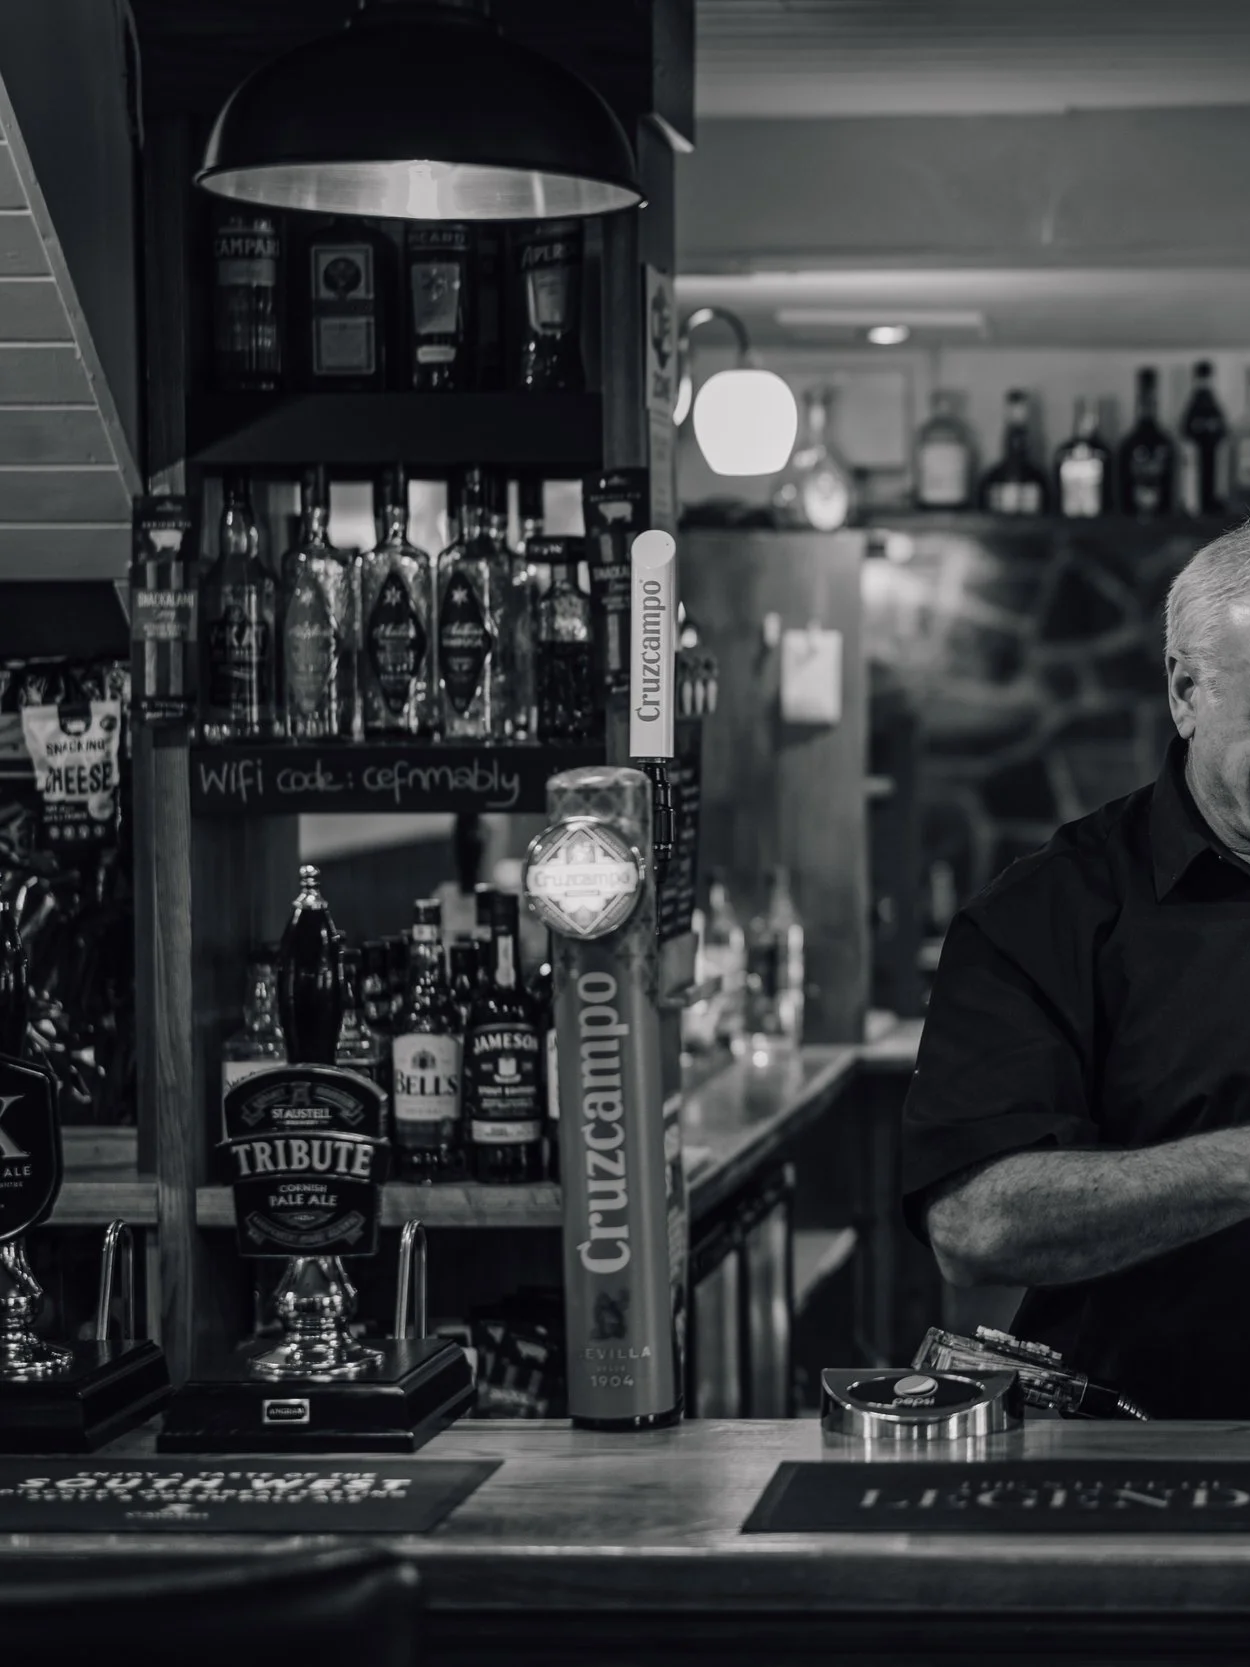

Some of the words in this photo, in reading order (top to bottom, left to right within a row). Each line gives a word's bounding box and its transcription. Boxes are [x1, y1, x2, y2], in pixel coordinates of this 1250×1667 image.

[213, 237, 280, 259] CAMPARI
[637, 579, 667, 723] Cruzcampo
[46, 740, 105, 756] SNACKING
[45, 761, 113, 795] CHEESE
[534, 870, 630, 888] Cruzcampo
[473, 1032, 539, 1056] JAMESON
[577, 970, 631, 1274] Cruzcampo
[230, 1139, 376, 1177] TRIBUTE
[3, 1164, 33, 1178] ALE
[278, 1183, 328, 1193] CORNISH
[268, 1193, 304, 1208] PALE
[307, 1194, 338, 1207] ALE
[579, 1345, 652, 1360] EVILLA
[590, 1374, 635, 1388] 1904
[17, 1478, 225, 1490] SOUTH
[250, 1478, 413, 1491] WEST
